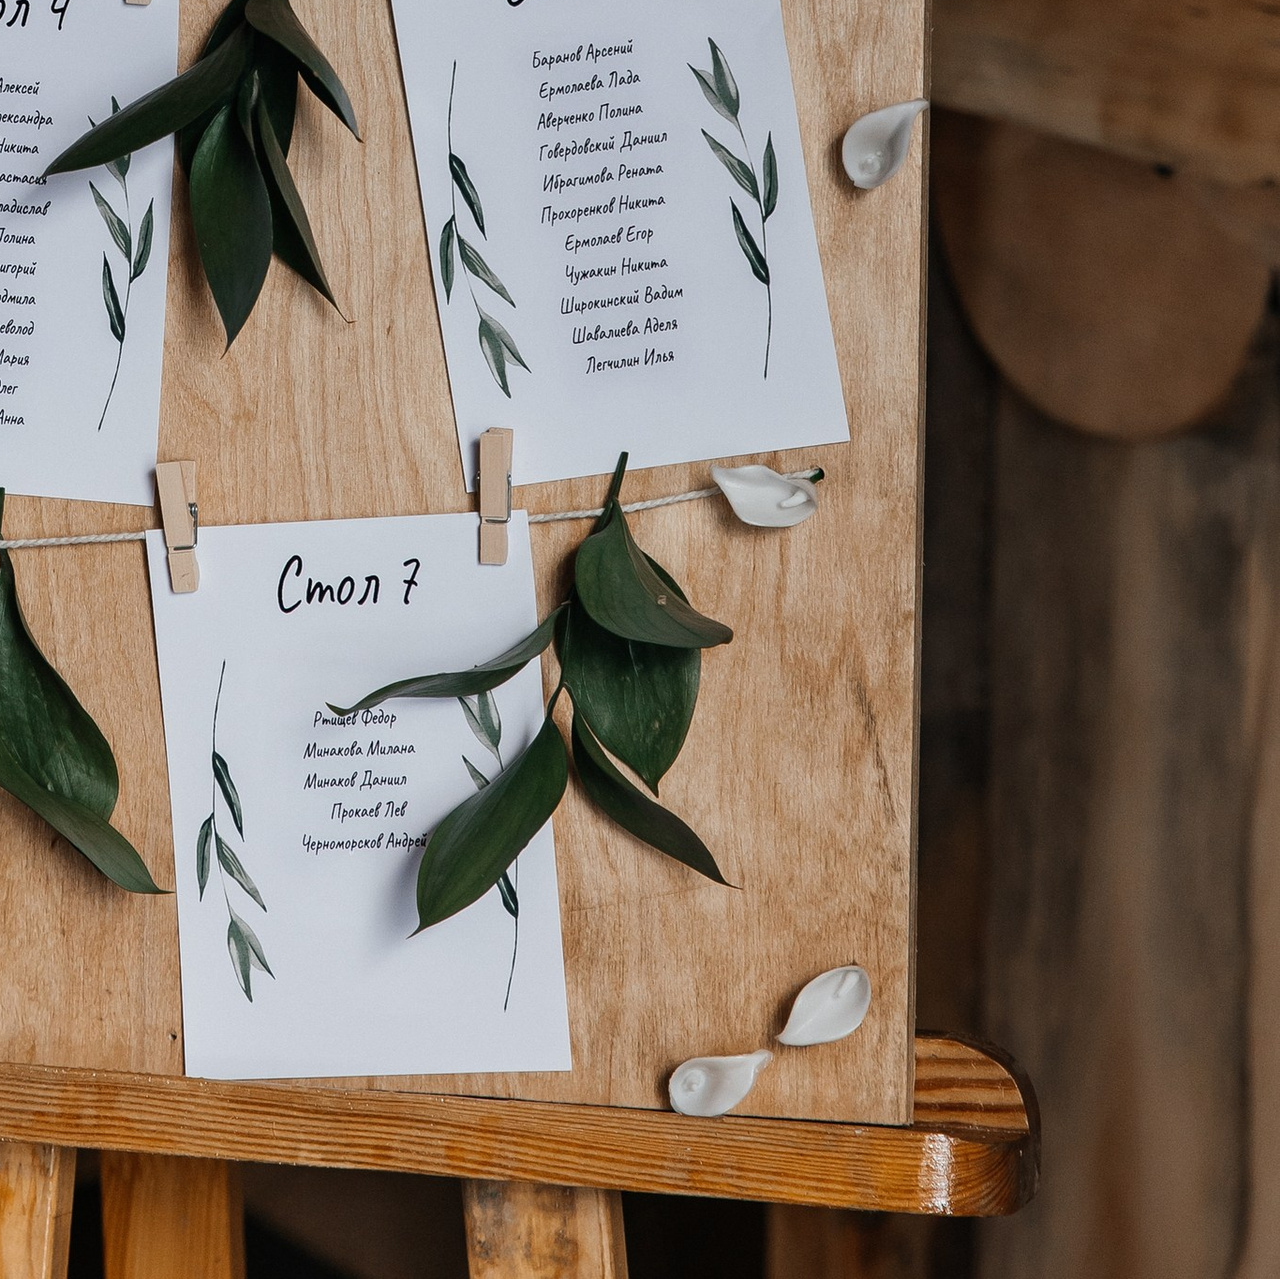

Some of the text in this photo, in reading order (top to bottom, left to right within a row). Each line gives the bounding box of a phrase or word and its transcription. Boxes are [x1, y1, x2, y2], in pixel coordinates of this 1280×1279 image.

[532, 39, 633, 71] Баранов Арсений
[539, 69, 641, 102] Ермолаева Лада
[537, 103, 643, 132] Аверченко Полина
[539, 130, 667, 162] Говердовский Даниил
[543, 164, 664, 194] Ибрагимова Рената
[565, 225, 654, 255] Ермолаев Егор
[565, 257, 668, 286] Чужакин Никита
[561, 284, 683, 315] Широкинский Вадим
[572, 317, 678, 344] Шавалиева Аделя
[586, 348, 674, 374] Легчилин Илья
[277, 554, 422, 613] Стол 7
[361, 709, 397, 729] Федор
[303, 740, 416, 759] Минакова Милана
[303, 770, 407, 791] Минаков Даниил
[331, 800, 408, 824] Прокаев Лев
[302, 831, 428, 855] Черноморсков Андрей
